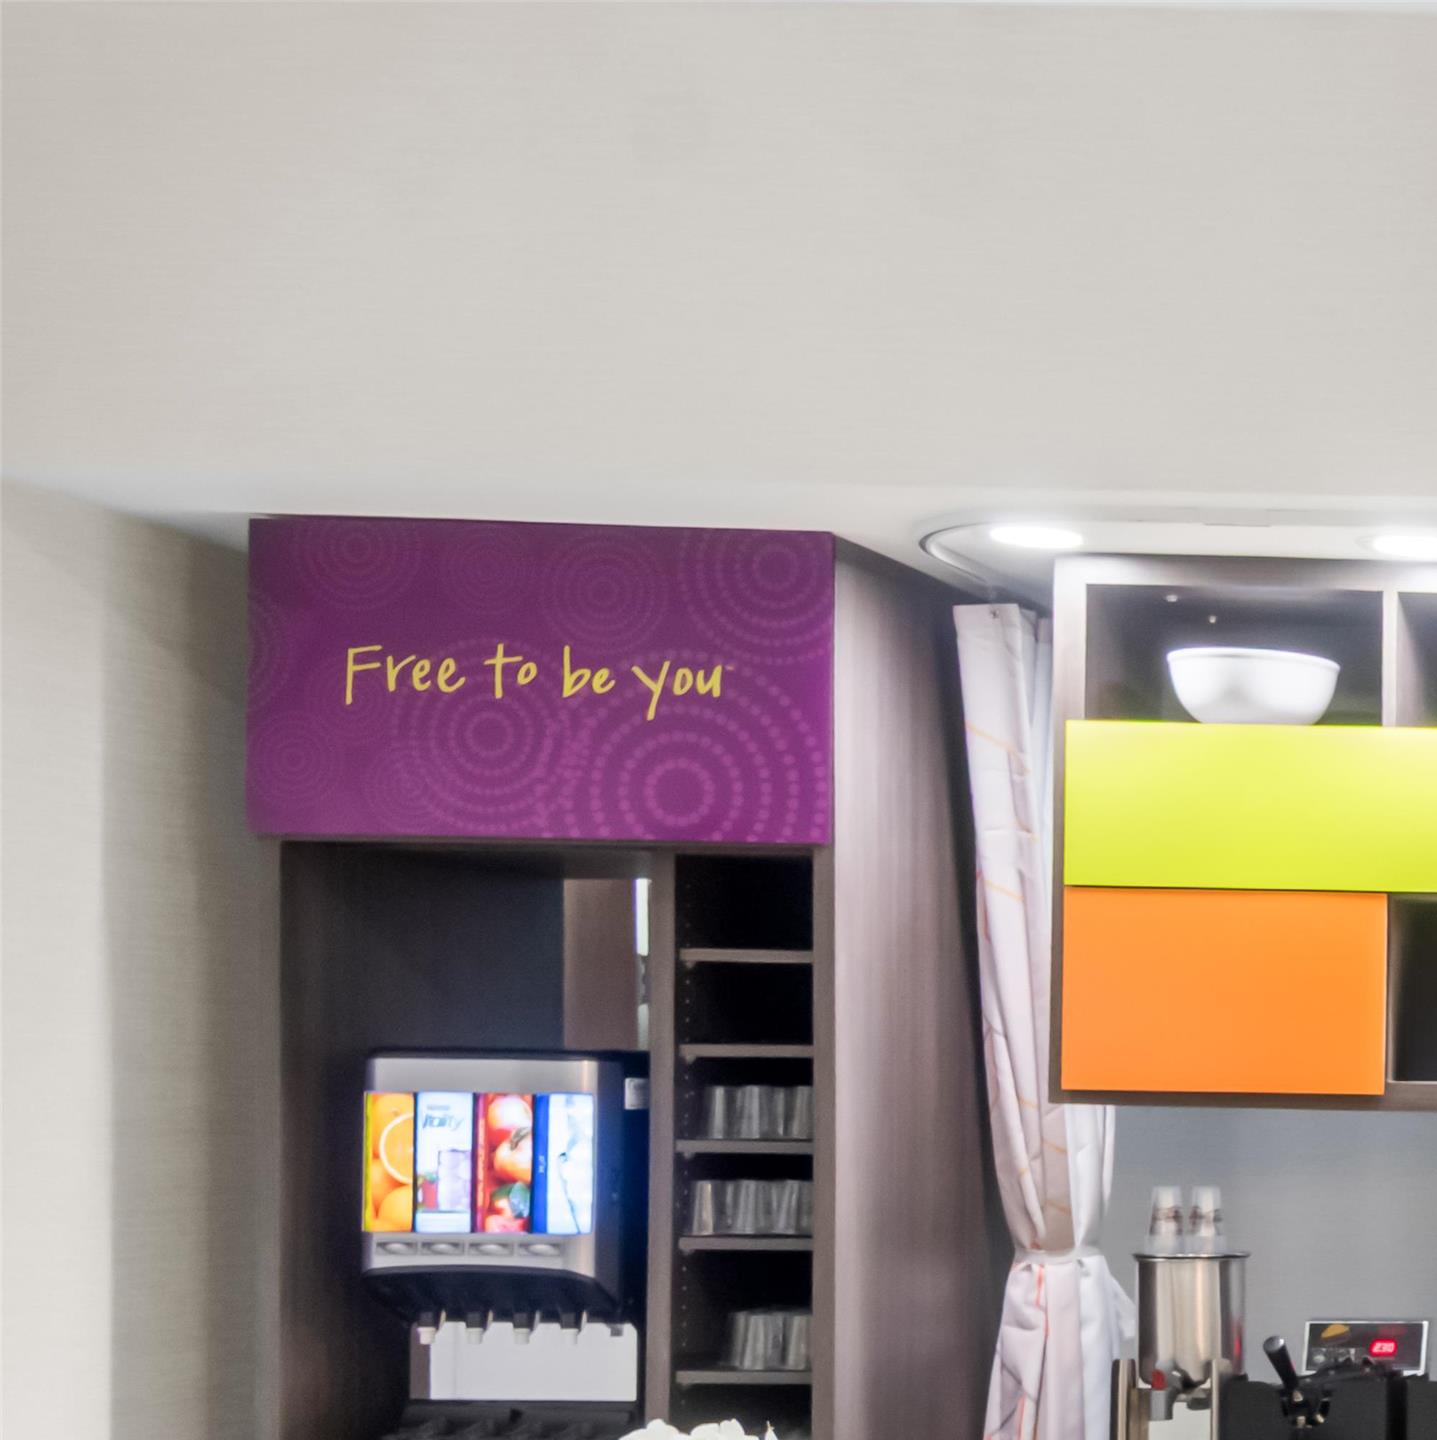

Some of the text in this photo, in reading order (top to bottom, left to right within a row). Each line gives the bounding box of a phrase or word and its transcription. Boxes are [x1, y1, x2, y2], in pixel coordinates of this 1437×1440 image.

[345, 642, 722, 721] Free to be you
